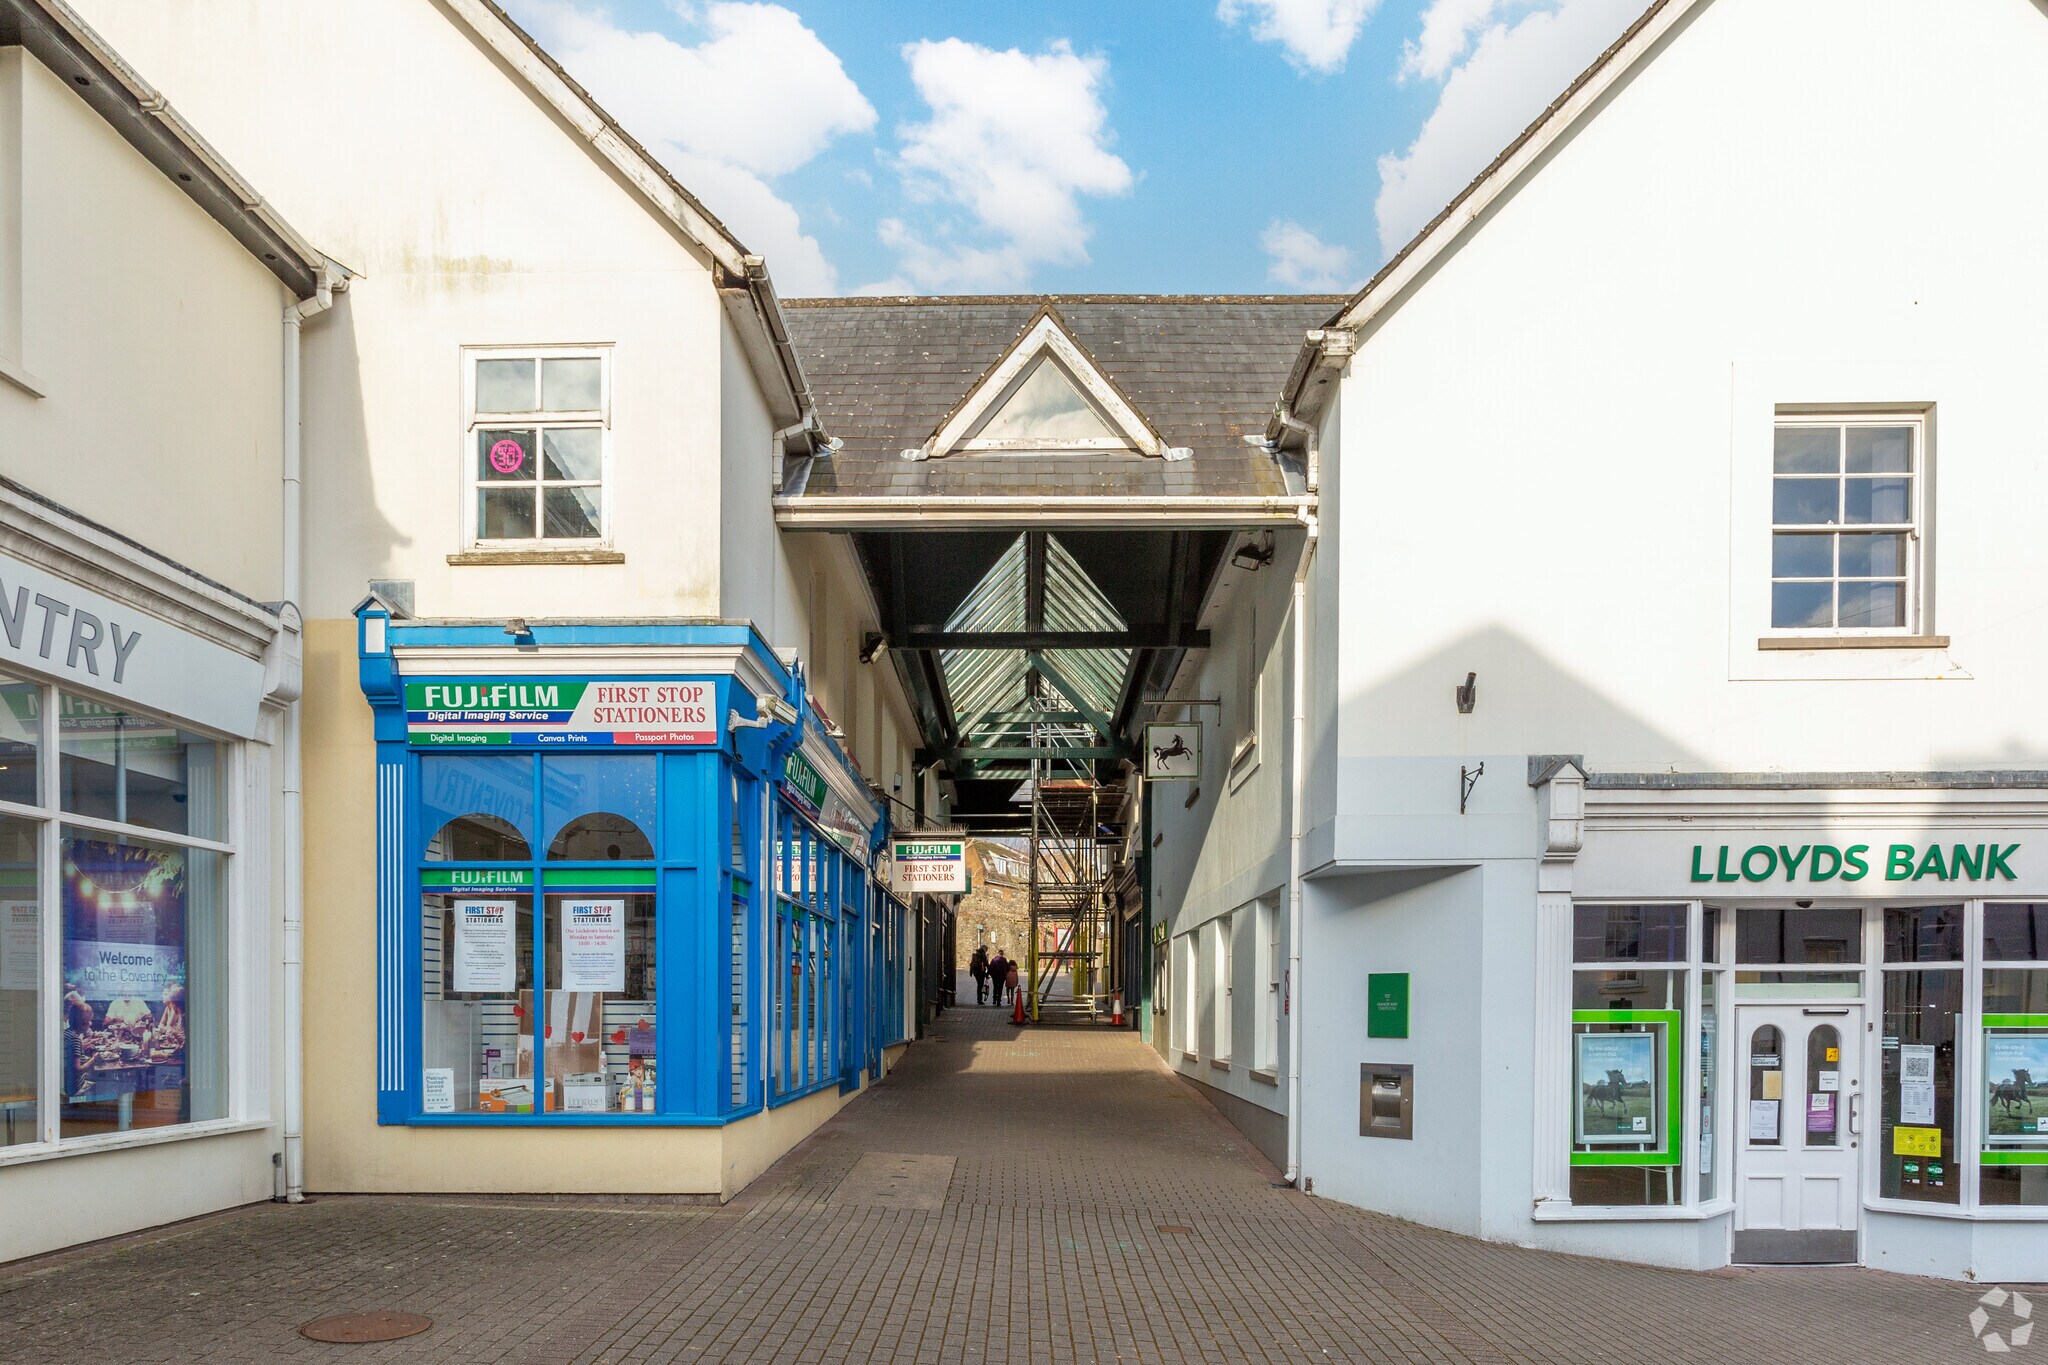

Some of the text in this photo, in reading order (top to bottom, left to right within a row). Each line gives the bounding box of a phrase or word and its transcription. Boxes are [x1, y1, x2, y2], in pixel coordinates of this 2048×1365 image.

[597, 686, 703, 703] FIRST STOP
[427, 711, 549, 722] Digital Imaging Service
[593, 707, 706, 724] STATIONERS
[430, 733, 487, 743] Digital Imaging
[537, 734, 588, 743] Canvas Prints
[635, 733, 695, 742] Passport Photos
[1690, 842, 2023, 883] LLOYDS BANK
[904, 864, 954, 872] FIRST STOP
[902, 873, 955, 882] STATIONERS
[465, 906, 505, 914] FIRST STOP
[573, 906, 612, 914] FIRST STOP
[99, 950, 153, 966] Welcome
[84, 968, 168, 986] to the Coventry
[568, 1096, 603, 1108] image
